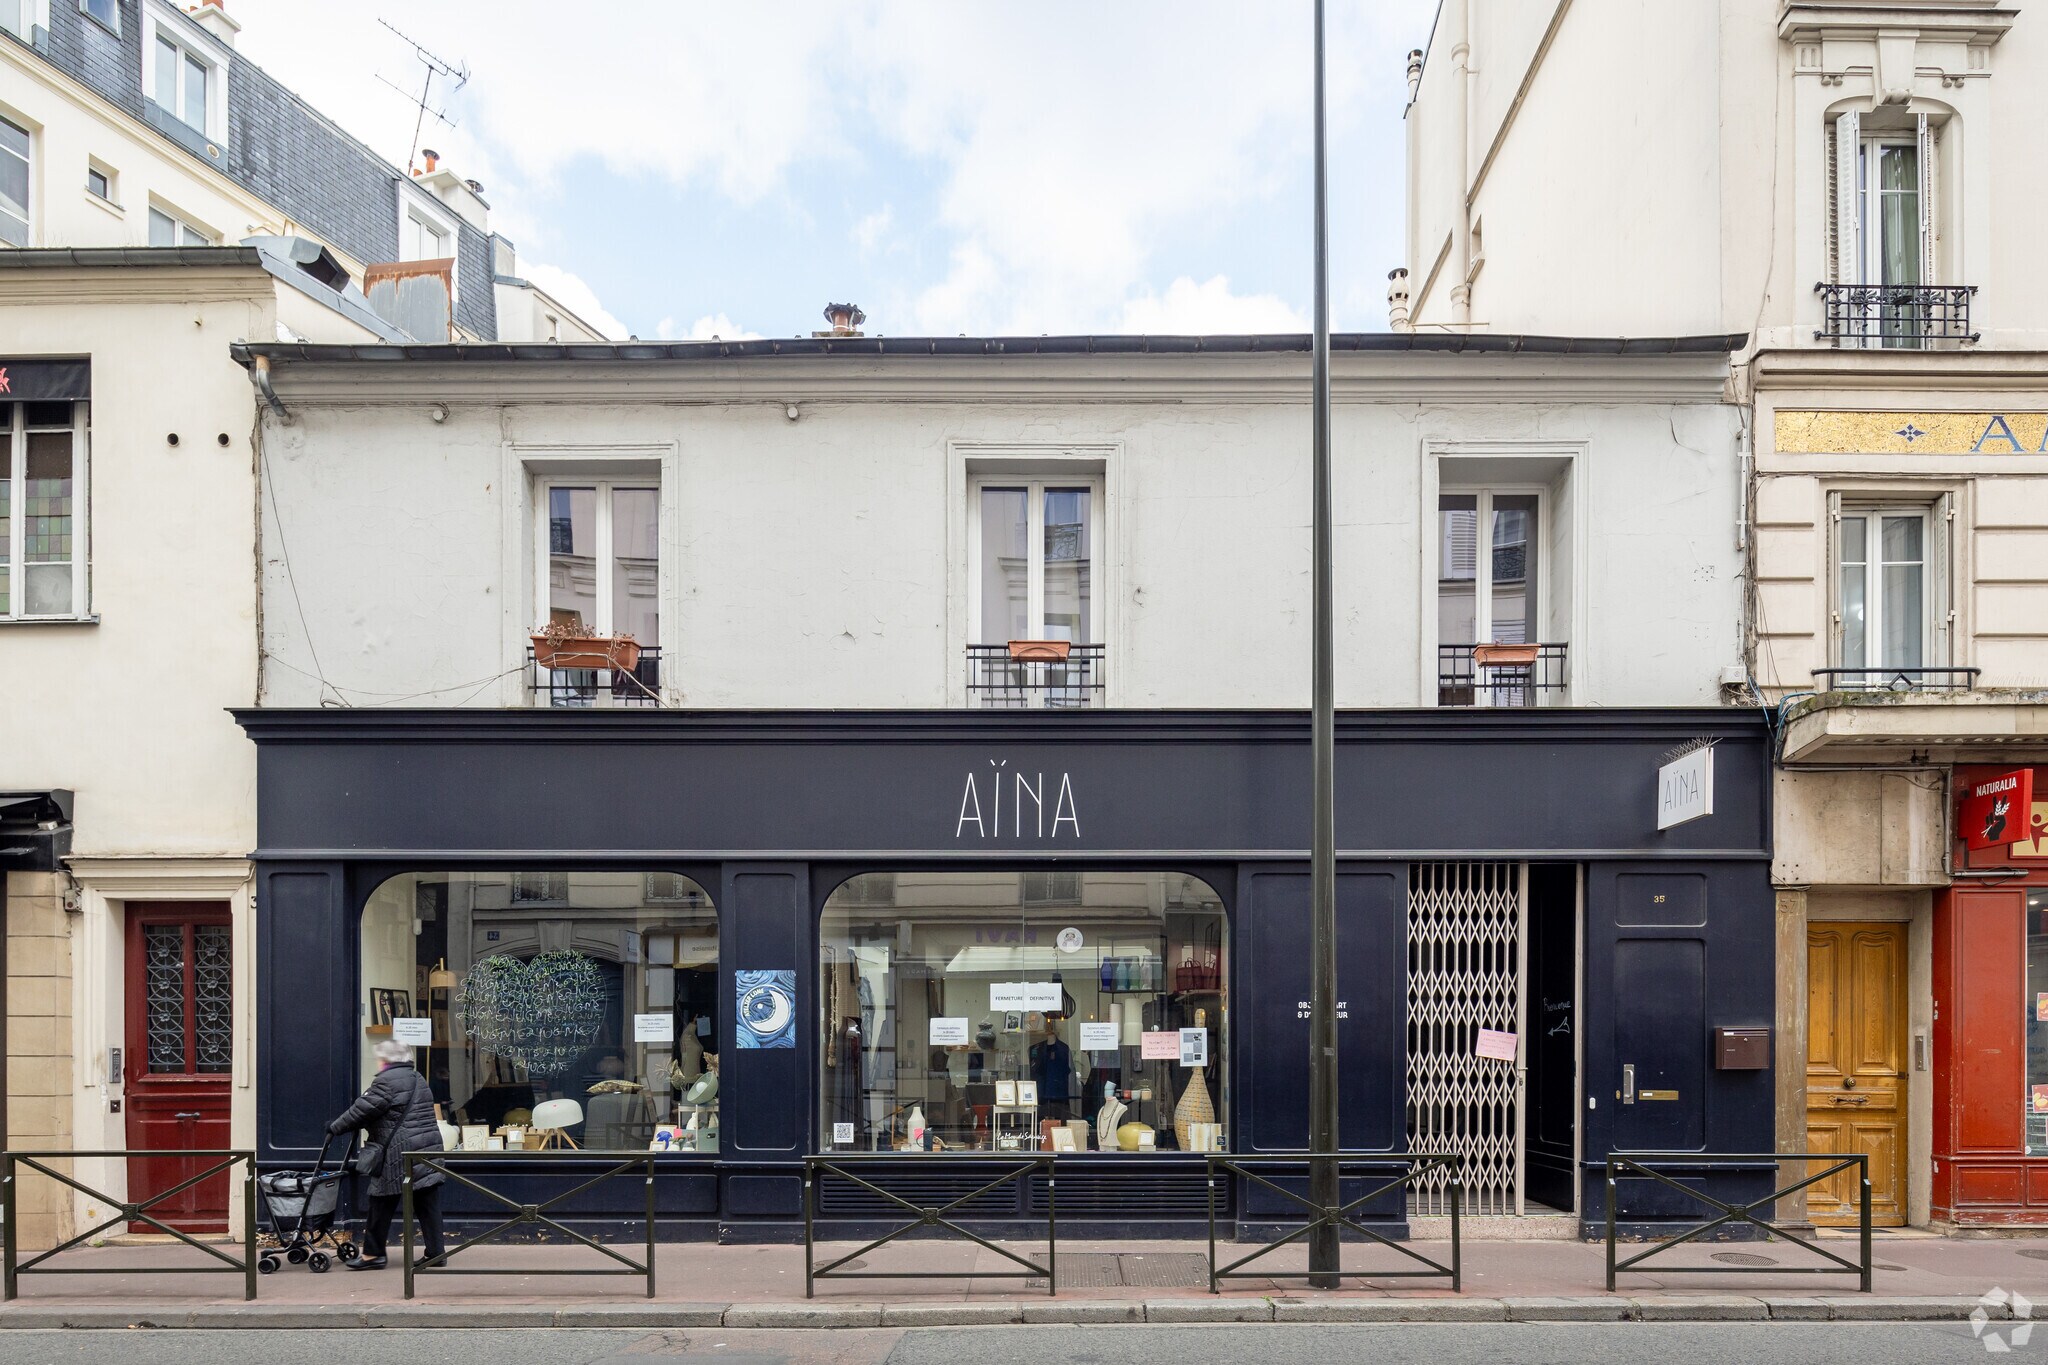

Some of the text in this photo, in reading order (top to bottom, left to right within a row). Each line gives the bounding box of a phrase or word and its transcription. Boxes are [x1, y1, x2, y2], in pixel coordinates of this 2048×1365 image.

[1971, 415, 2048, 452] A
[956, 759, 1080, 838] AÏNA
[1664, 769, 1699, 812] AÏNA
[1976, 776, 2017, 798] NATURALIA
[1653, 895, 1666, 903] 35
[1779, 899, 1796, 914] 37
